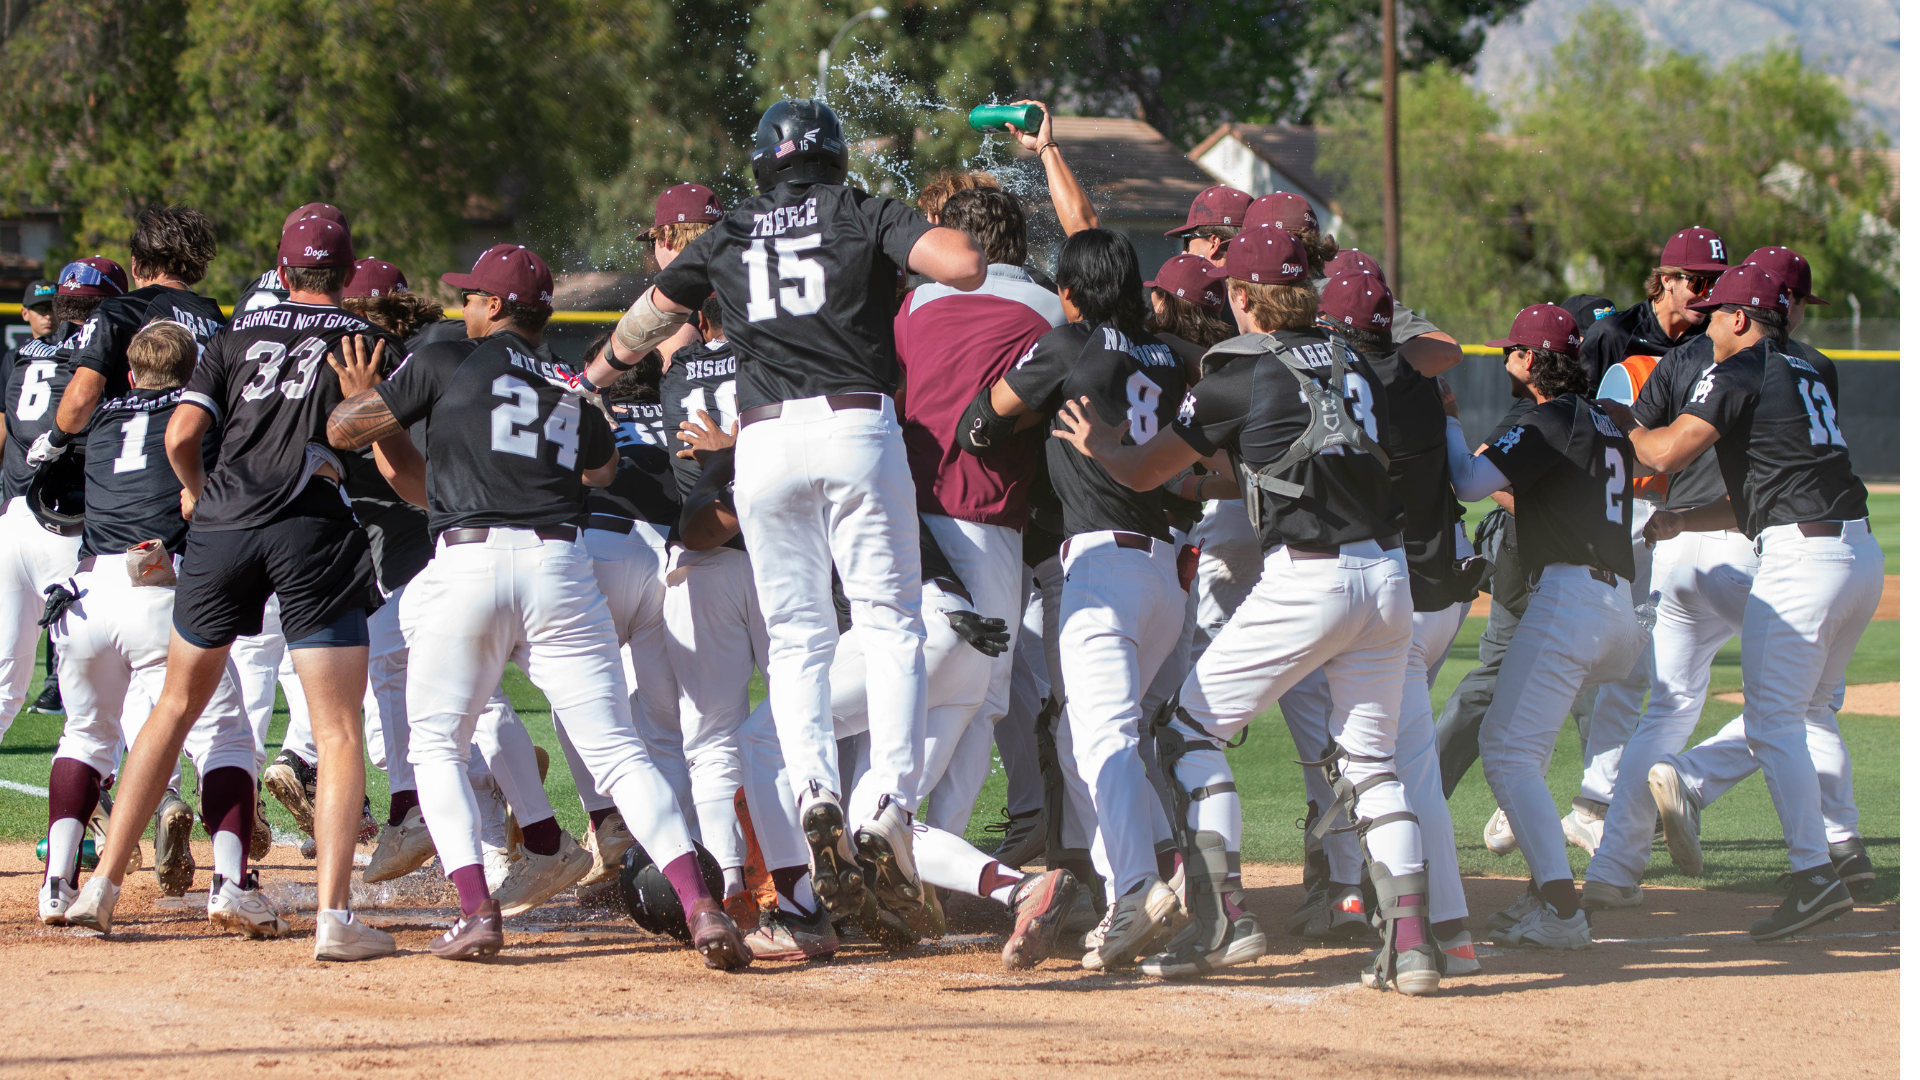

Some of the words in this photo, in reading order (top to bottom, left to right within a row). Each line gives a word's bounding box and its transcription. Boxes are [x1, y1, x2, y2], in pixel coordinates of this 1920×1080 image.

[800, 140, 809, 151] 15
[304, 246, 329, 260] Dogs
[742, 233, 827, 322] 15
[1282, 263, 1303, 277] Dogs
[1709, 239, 1725, 259] R
[232, 310, 292, 332] EARNED
[293, 313, 326, 330] NOT
[324, 313, 370, 332] GIVEN
[1205, 291, 1222, 306] Dogs
[1372, 313, 1391, 327] Dogs
[16, 360, 58, 421] 6
[241, 336, 328, 402] 33
[491, 373, 582, 471] 24
[1126, 369, 1163, 446] 8
[1797, 377, 1848, 448] 12
[114, 412, 150, 474] 1
[1604, 446, 1626, 525] 2
